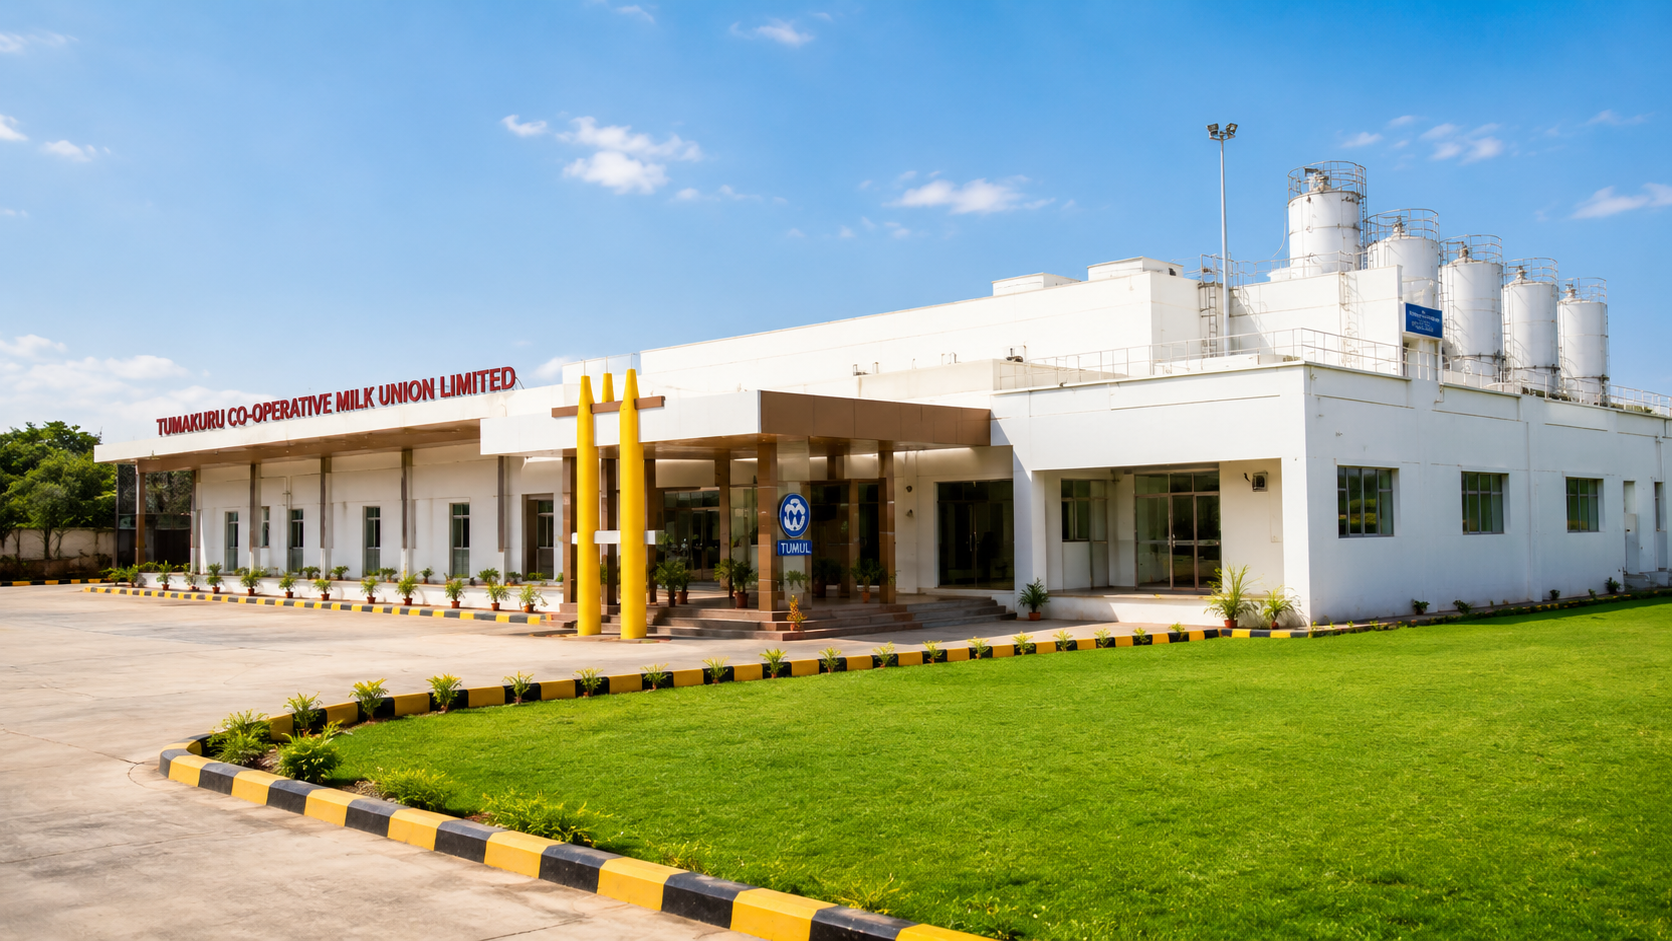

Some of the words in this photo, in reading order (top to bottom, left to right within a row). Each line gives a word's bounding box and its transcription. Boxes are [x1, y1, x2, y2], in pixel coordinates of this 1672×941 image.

[156, 409, 225, 436] TUMAKURU
[228, 393, 332, 427] CO-OPERATIVE
[336, 386, 375, 412] MILK
[379, 377, 434, 406] UNION
[440, 366, 516, 398] LIMITED
[780, 542, 811, 554] TUMUL
